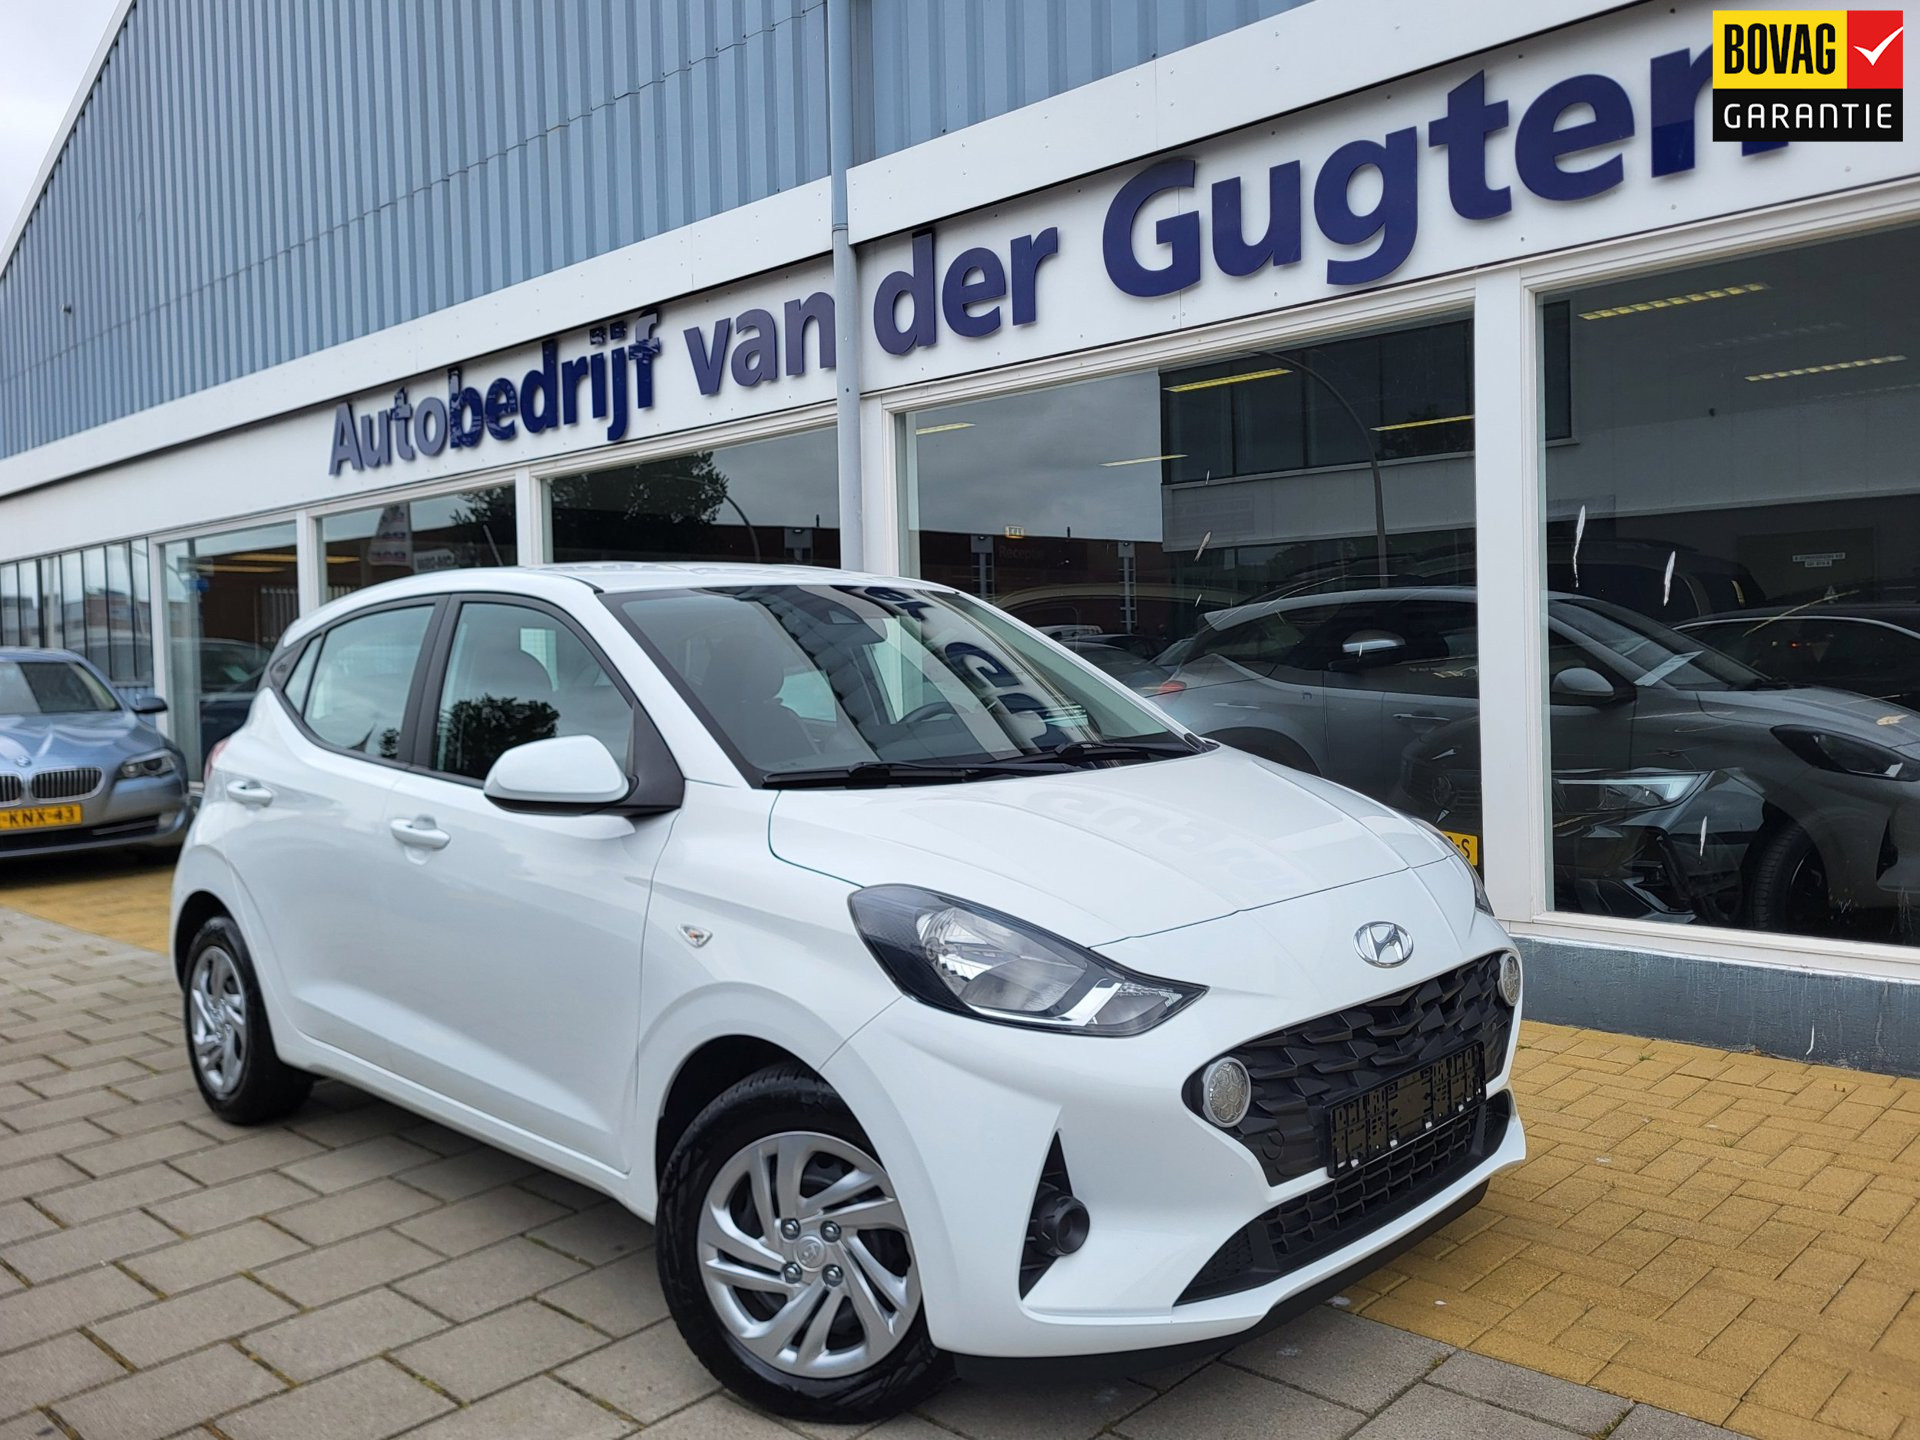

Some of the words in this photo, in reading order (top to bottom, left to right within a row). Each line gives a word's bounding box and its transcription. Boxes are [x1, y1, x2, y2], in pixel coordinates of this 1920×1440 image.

[328, 309, 661, 475] Autobedrijf
[683, 292, 836, 396] van
[874, 227, 1058, 356] der
